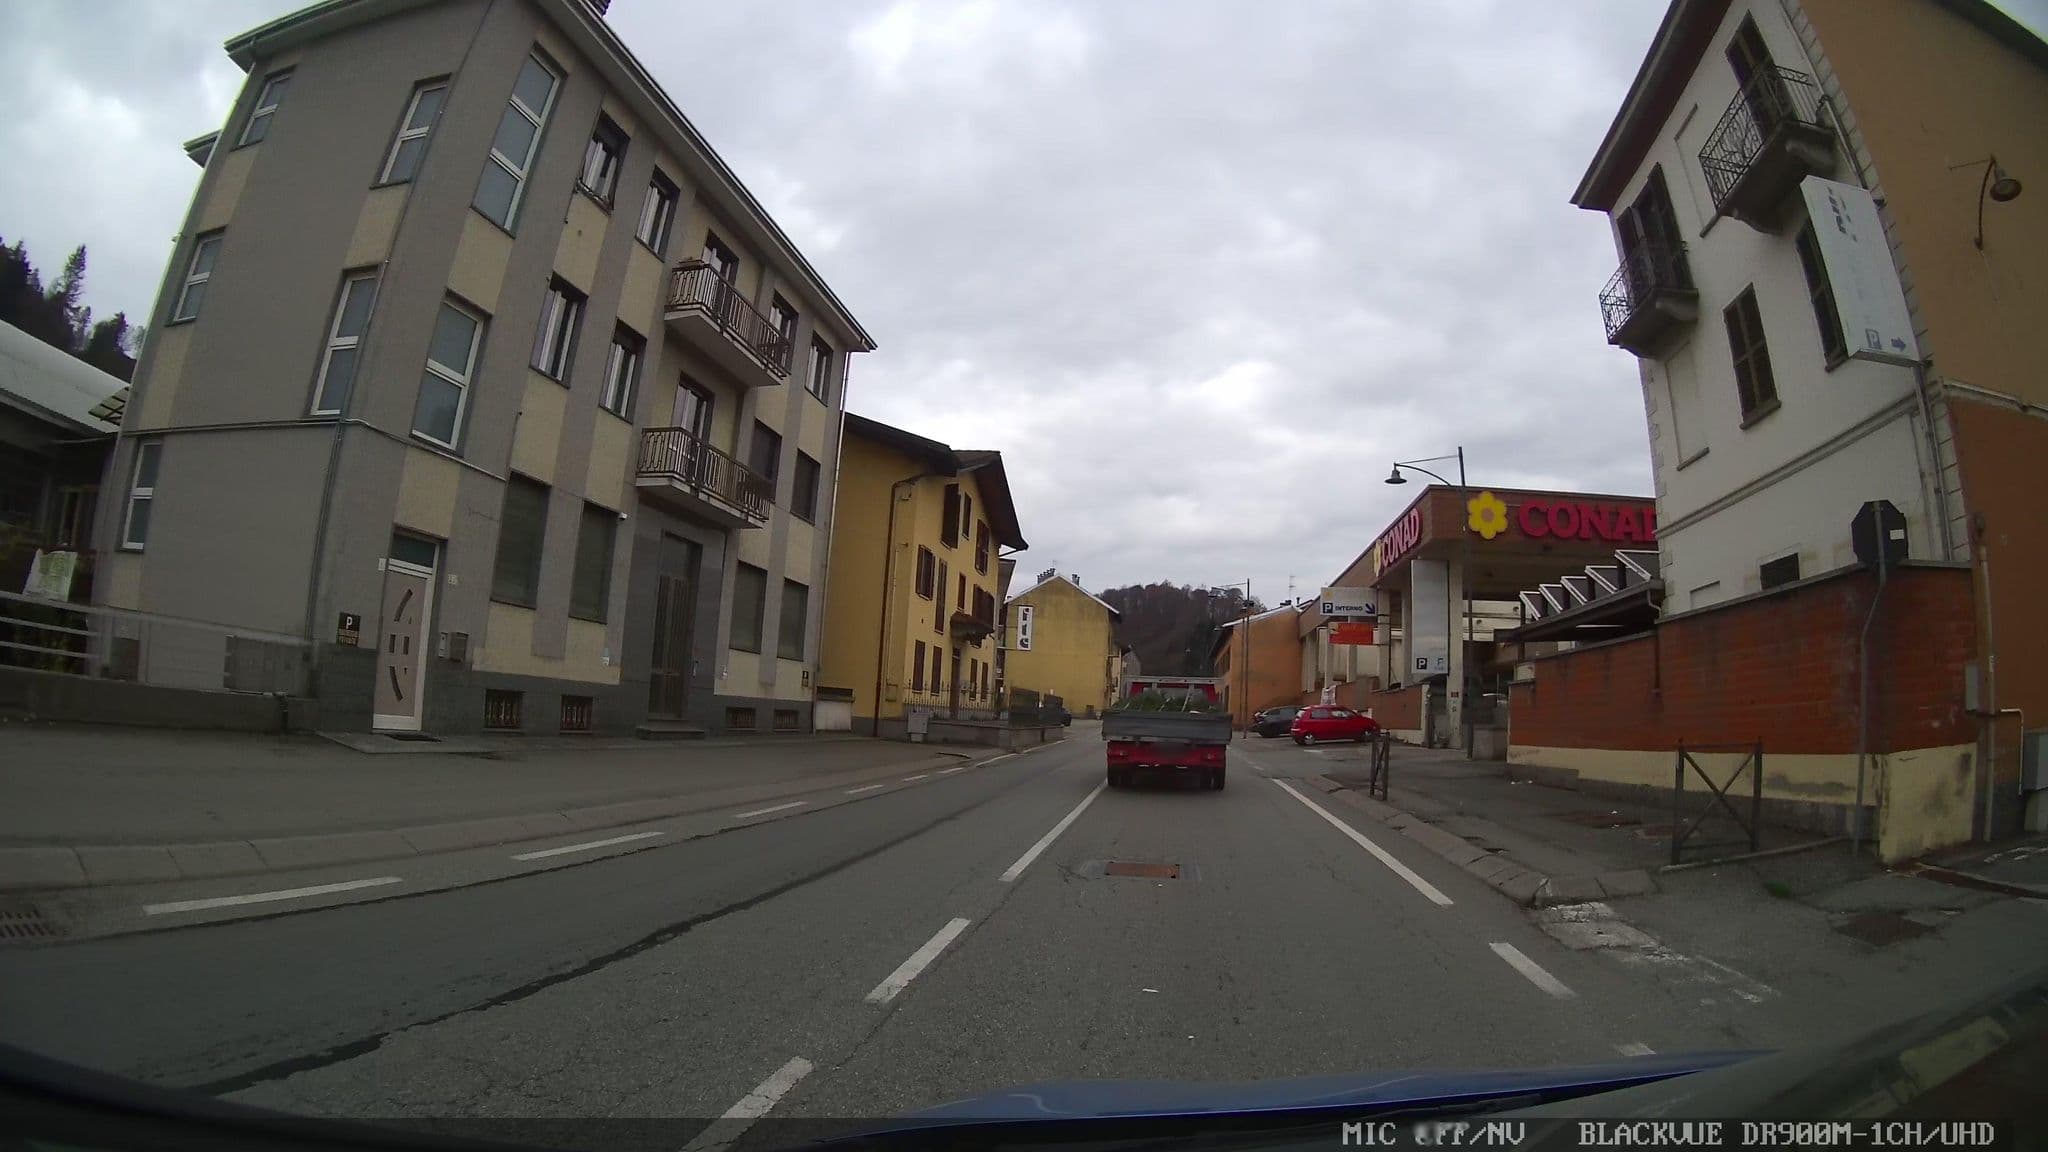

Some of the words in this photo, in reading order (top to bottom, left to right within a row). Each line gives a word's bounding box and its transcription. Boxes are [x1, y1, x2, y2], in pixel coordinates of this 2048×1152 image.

[1381, 508, 1420, 567] CONAD
[1324, 603, 1333, 613] P
[346, 616, 353, 630] P
[1417, 658, 1427, 669] P
